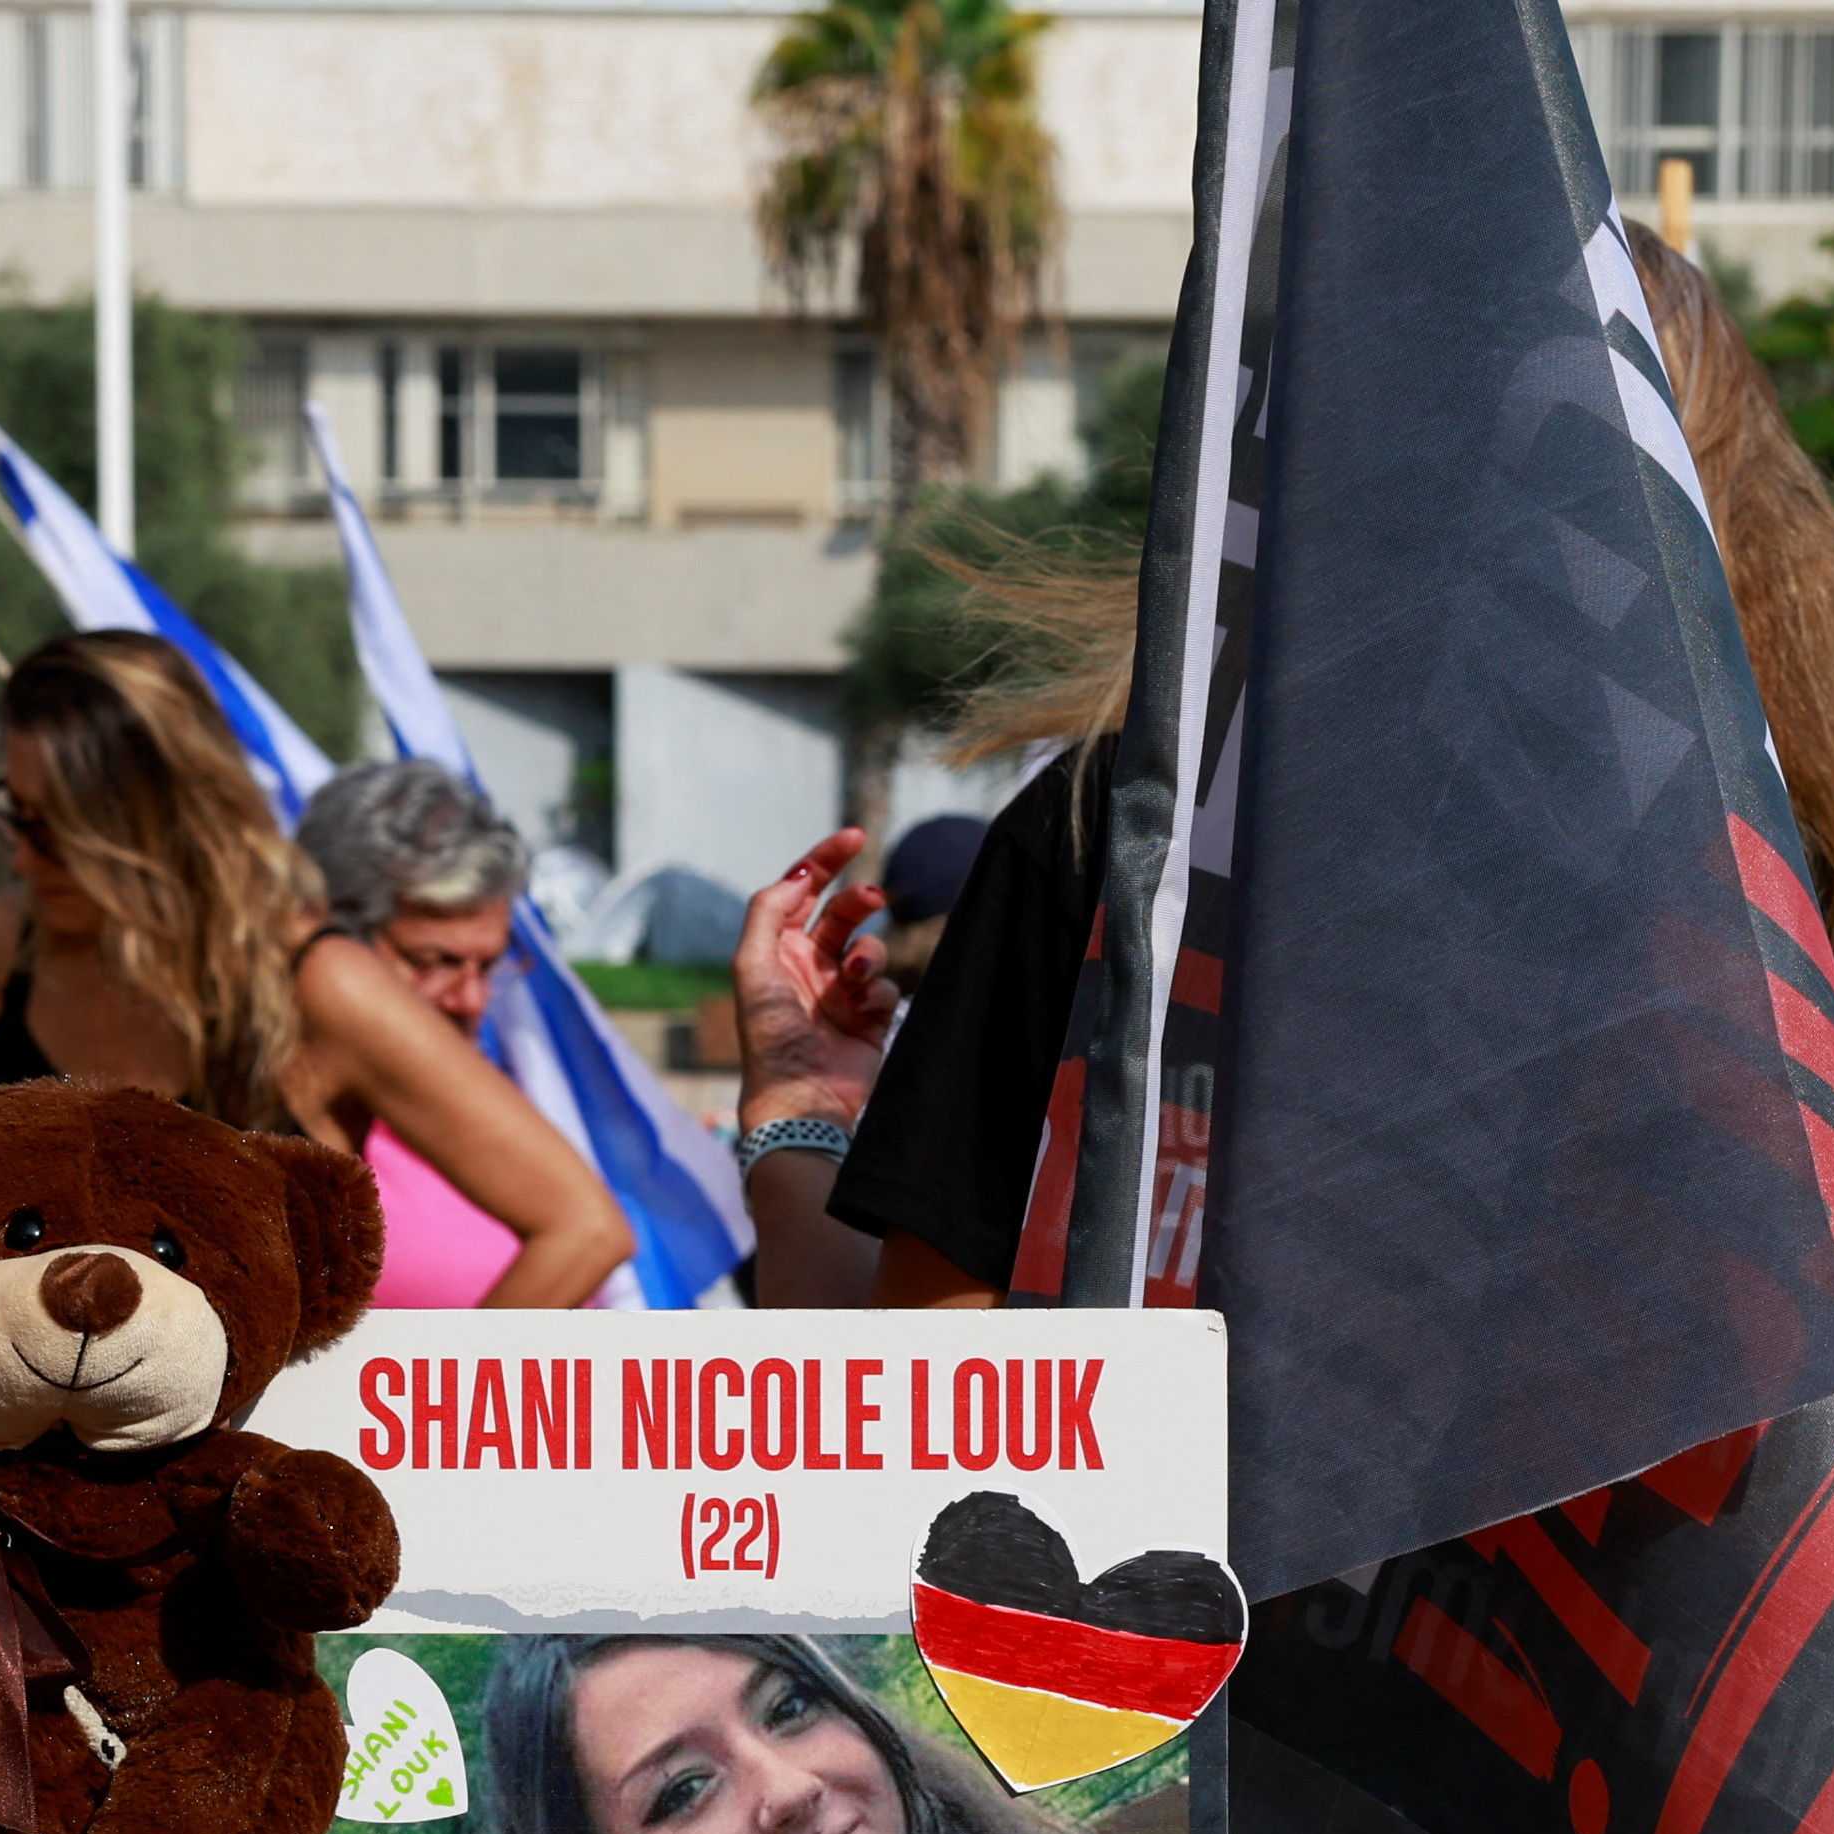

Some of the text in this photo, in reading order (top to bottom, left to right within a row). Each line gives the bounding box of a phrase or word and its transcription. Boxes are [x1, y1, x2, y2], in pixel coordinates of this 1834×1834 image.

[358, 1357, 1105, 1472] SHANI NICOLE LOUK
[680, 1493, 781, 1580] (22)
[341, 1699, 418, 1801] SHANI
[373, 1729, 449, 1820] LOUK
